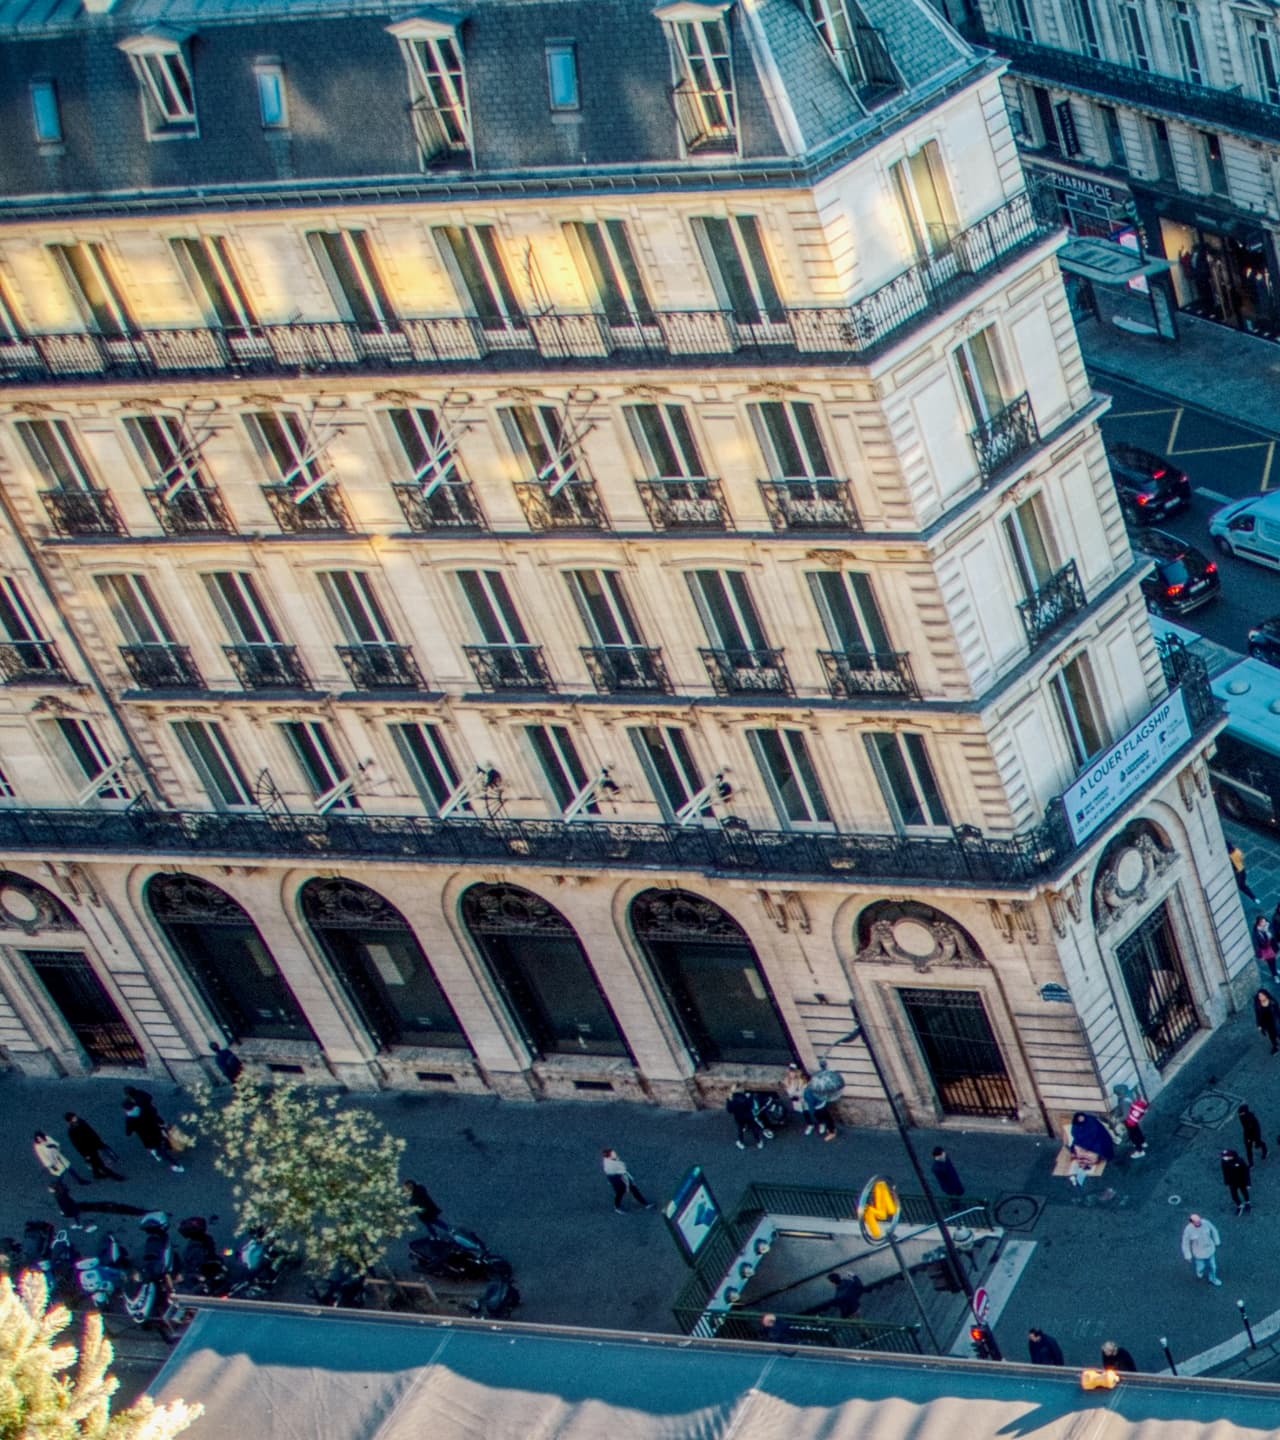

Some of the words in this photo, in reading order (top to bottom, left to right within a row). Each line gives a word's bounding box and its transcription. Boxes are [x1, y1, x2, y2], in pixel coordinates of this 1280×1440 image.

[1050, 172, 1112, 200] PHARMACIE
[1079, 786, 1087, 798] A
[1087, 750, 1122, 788] LOUER
[1124, 705, 1170, 757] FLAGSHIP
[864, 1181, 897, 1239] M
